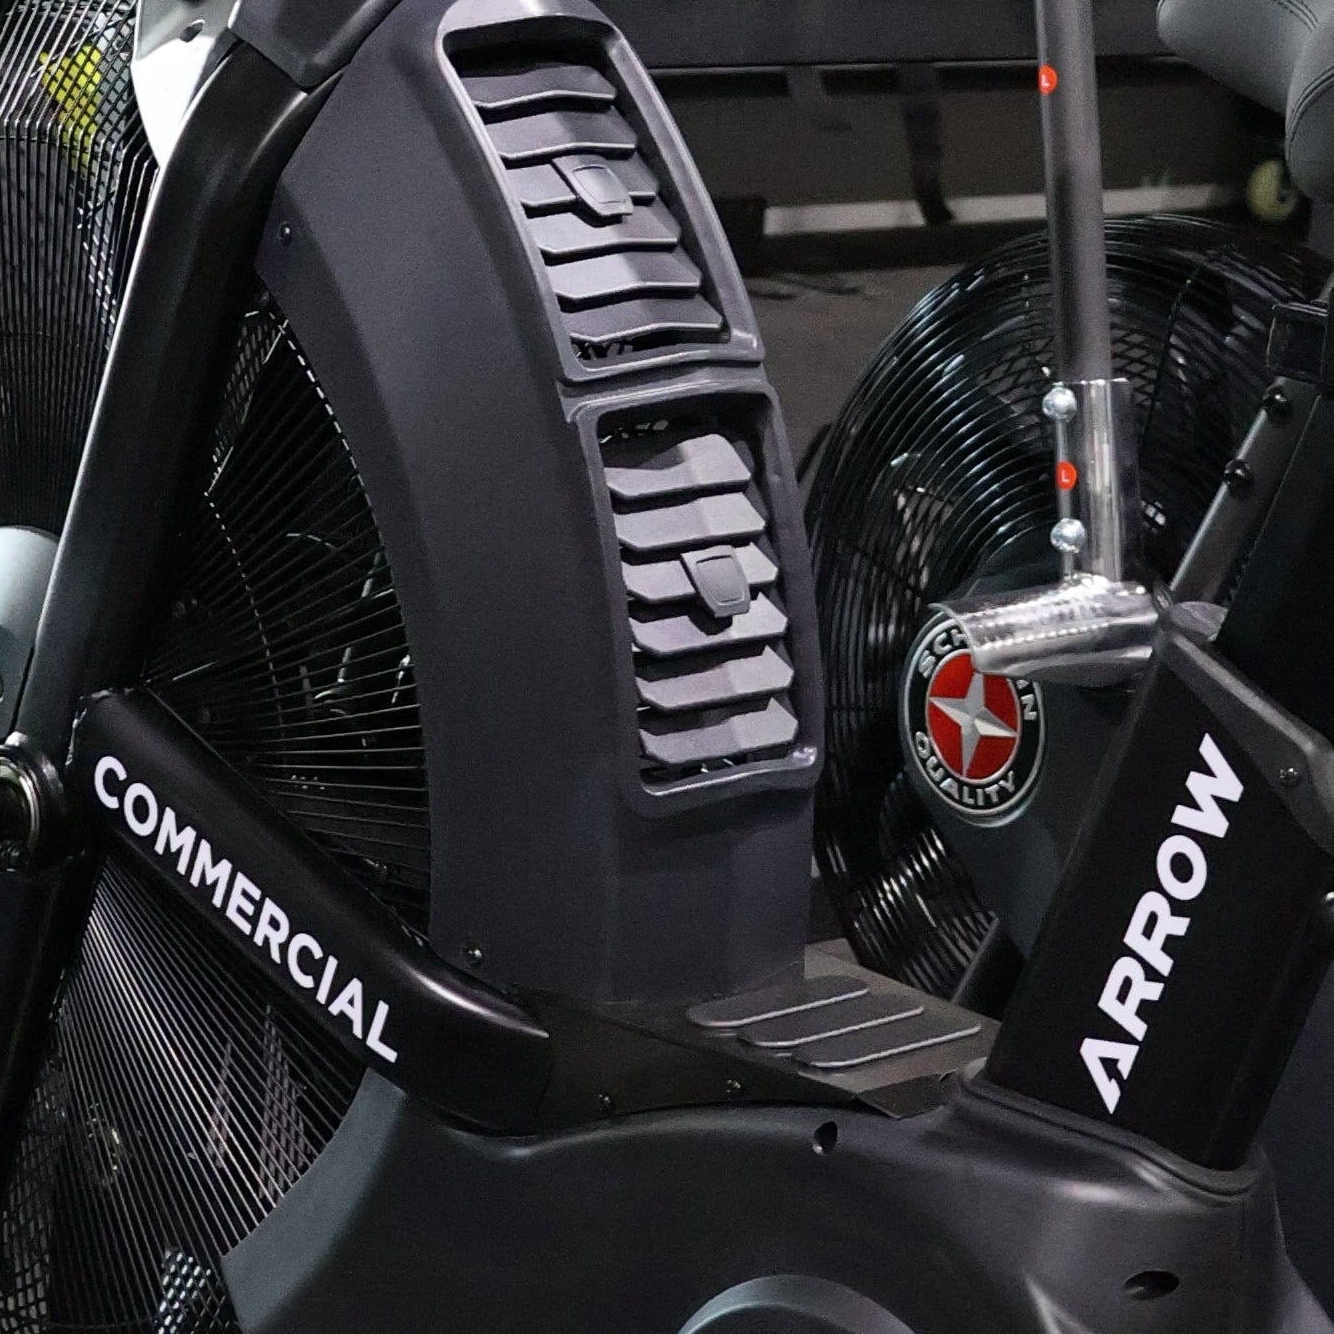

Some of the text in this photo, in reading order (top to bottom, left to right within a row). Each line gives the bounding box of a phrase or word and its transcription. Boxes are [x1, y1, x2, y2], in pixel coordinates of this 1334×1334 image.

[94, 755, 398, 1064] COMMERCIAL
[915, 730, 1016, 807] QUALITY
[1079, 732, 1244, 1115] ARROW
